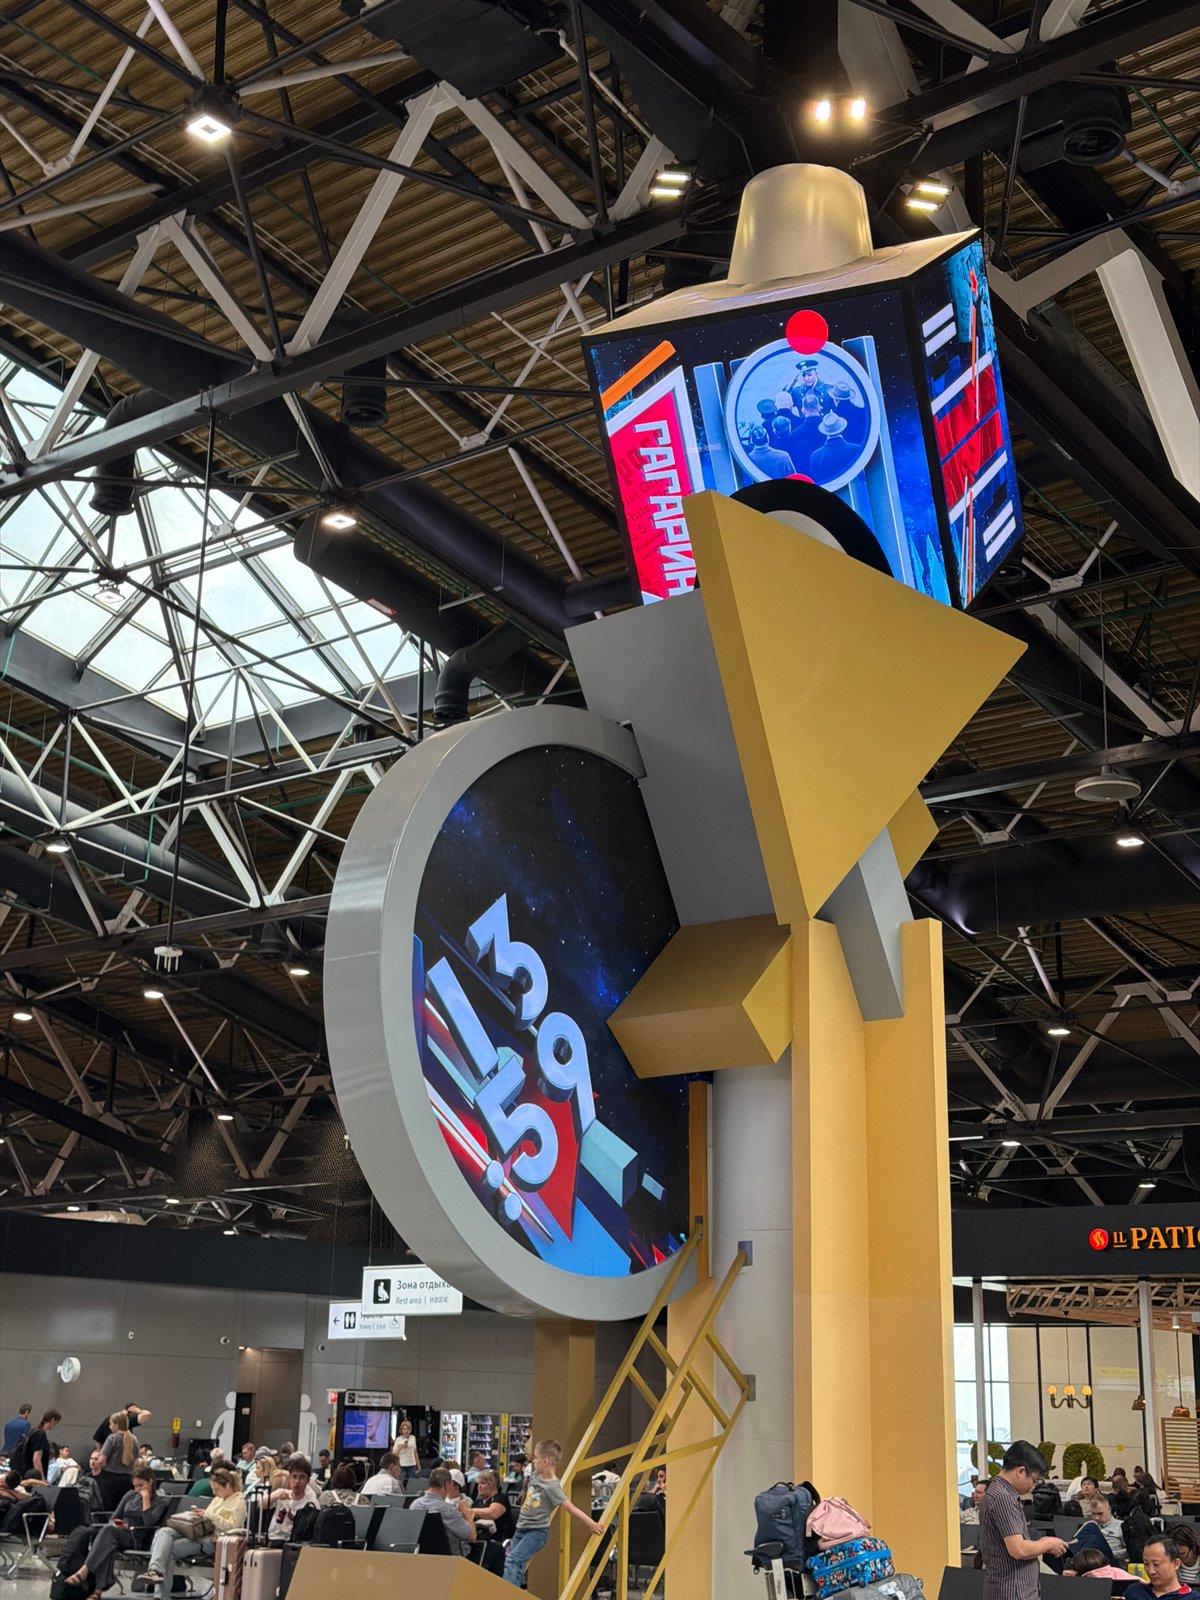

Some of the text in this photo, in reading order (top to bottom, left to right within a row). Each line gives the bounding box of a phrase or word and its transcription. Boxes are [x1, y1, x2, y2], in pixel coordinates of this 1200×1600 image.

[633, 419, 697, 597] ГАГАРИН
[1112, 1231, 1127, 1244] IL
[396, 1280, 418, 1290] Зона
[395, 1296, 408, 1305] Rest
[409, 1297, 422, 1305] area
